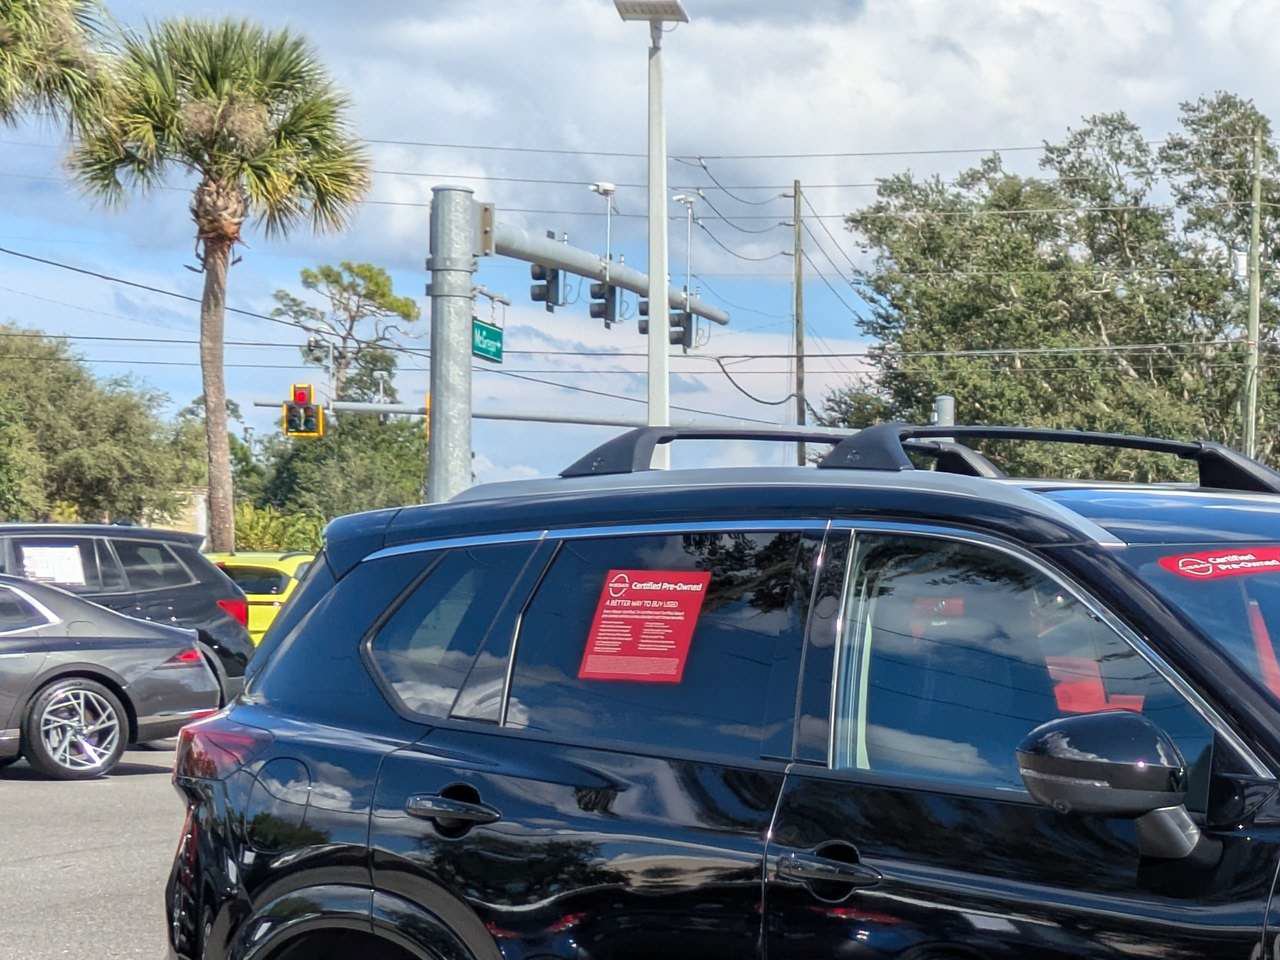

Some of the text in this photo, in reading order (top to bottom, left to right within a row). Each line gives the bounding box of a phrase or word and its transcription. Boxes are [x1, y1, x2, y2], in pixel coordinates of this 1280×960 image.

[1208, 553, 1256, 566] Certified
[1217, 559, 1280, 571] Pre-Owned
[631, 582, 703, 591] Certified Pre-Owned
